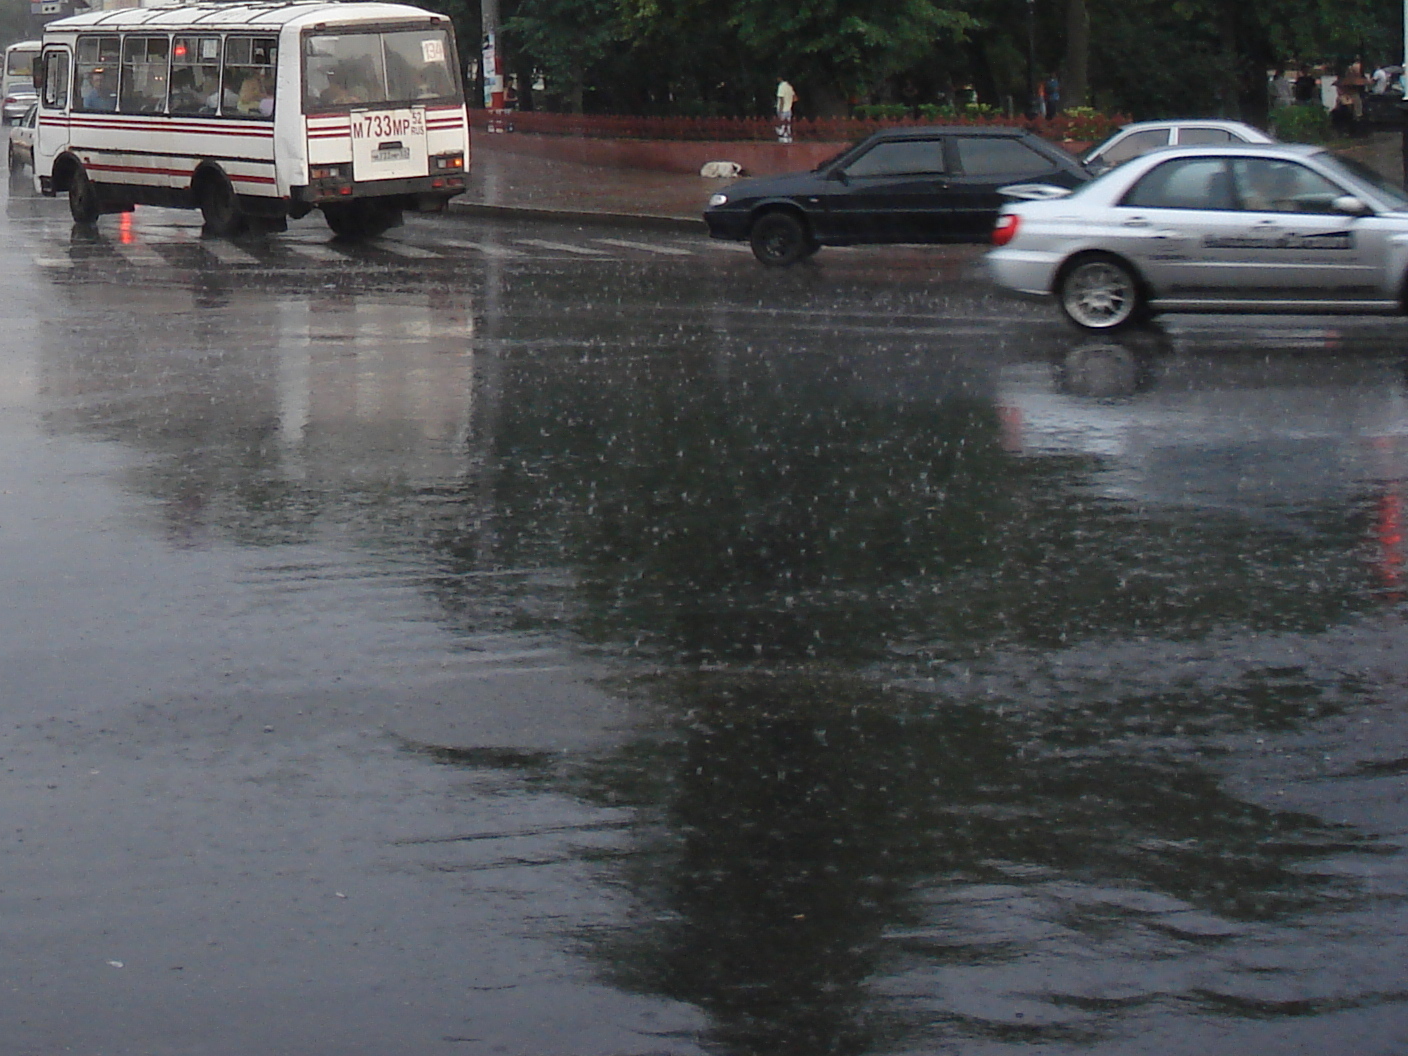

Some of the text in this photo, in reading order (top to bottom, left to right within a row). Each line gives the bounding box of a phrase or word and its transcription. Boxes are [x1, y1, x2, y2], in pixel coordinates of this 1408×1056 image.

[424, 43, 443, 60] 134
[412, 112, 422, 124] 52
[411, 126, 425, 135] RUS
